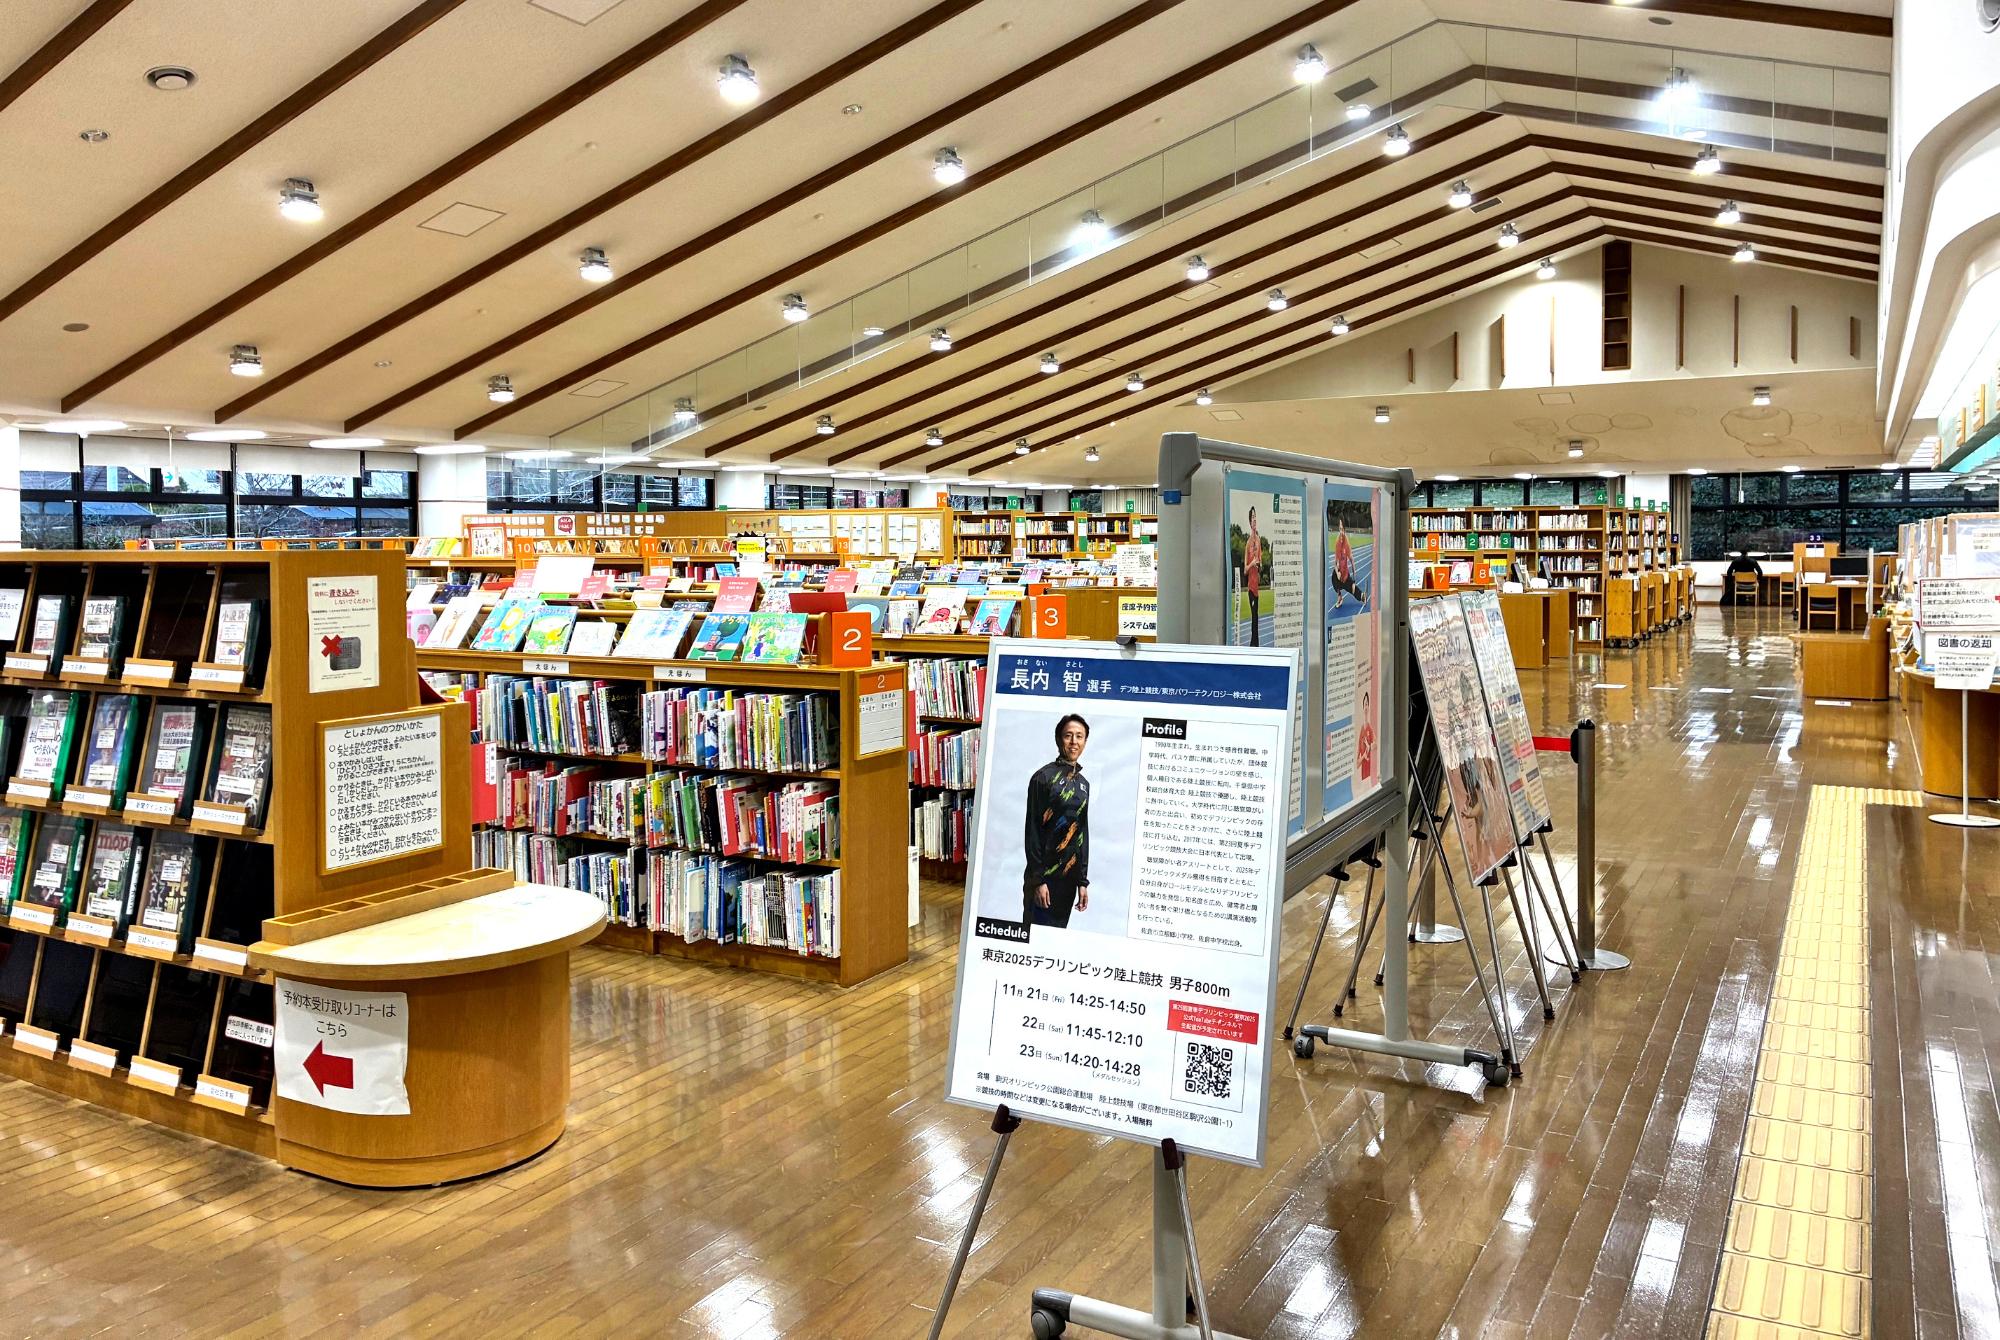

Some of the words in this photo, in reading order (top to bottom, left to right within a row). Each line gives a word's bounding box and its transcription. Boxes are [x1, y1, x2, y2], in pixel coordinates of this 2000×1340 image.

[645, 543, 655, 552] 11
[838, 541, 848, 549] 13
[1430, 538, 1437, 547] 9
[1469, 538, 1476, 546] 2
[1503, 537, 1509, 545] 3
[517, 544, 531, 553] 10
[1438, 573, 1446, 583] 7
[1479, 569, 1486, 579] 8
[1044, 607, 1059, 627] 3
[842, 628, 862, 651] 2
[1938, 638, 1992, 649] 図書の返却
[1035, 659, 1048, 667] ない
[668, 670, 692, 678] えほん
[877, 675, 885, 689] 2
[1010, 668, 1050, 691] 長内
[1062, 670, 1082, 693] 智
[1086, 680, 1112, 693] 選手
[1119, 685, 1262, 700] デフ陸上競技/東京パワーテクノロジー株式会社
[344, 721, 423, 739] としょかんのつかいかた
[1145, 723, 1183, 736] Profile
[978, 922, 1028, 939] Schedule
[982, 947, 1163, 988] 東京2025デフリンピック陸上競技
[1169, 975, 1231, 998] 男子800m
[283, 990, 397, 1019] 予約本受け取りコーナーは
[1002, 983, 1023, 997] 11月
[1026, 987, 1049, 1001] 21日
[1069, 992, 1146, 1016] 14:25-14:50
[316, 1019, 348, 1038] こちら
[1022, 1015, 1045, 1031] 22日
[1066, 1023, 1143, 1048] 11:45-12:10
[1019, 1043, 1042, 1059] 23日
[1064, 1051, 1141, 1077] 14:20-14:28
[976, 1071, 990, 1081] 会場
[995, 1074, 1093, 1101] 駒沢オリンピック公園総合運動場
[1099, 1094, 1134, 1109] 陸上競技場
